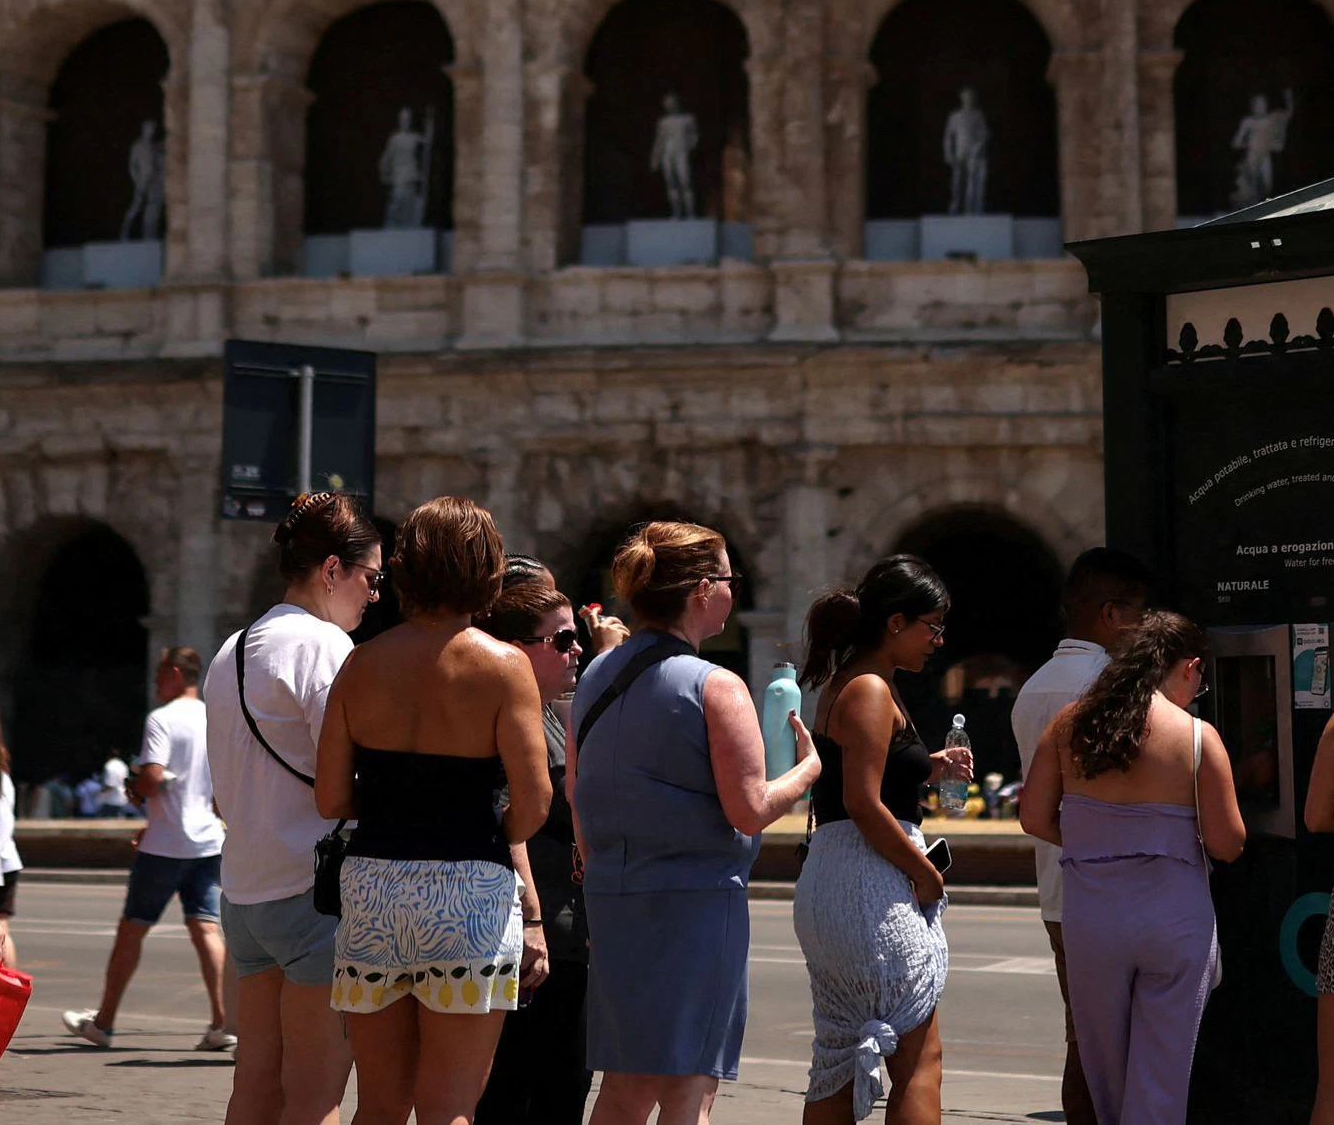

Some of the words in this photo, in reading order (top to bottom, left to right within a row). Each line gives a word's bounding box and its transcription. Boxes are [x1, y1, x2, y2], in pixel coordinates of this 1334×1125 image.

[1188, 477, 1214, 505] Acqua
[1214, 454, 1252, 484] potabile,
[1252, 440, 1288, 460] trattata
[1290, 439, 1298, 448] e
[1234, 484, 1266, 507] Drinking
[1266, 477, 1290, 491] water,
[1291, 473, 1320, 483] treated
[1236, 544, 1268, 557] Acqua
[1271, 545, 1278, 554] a
[1284, 558, 1307, 568] Water
[1308, 557, 1320, 567] for
[1217, 580, 1269, 592] NATURALE
